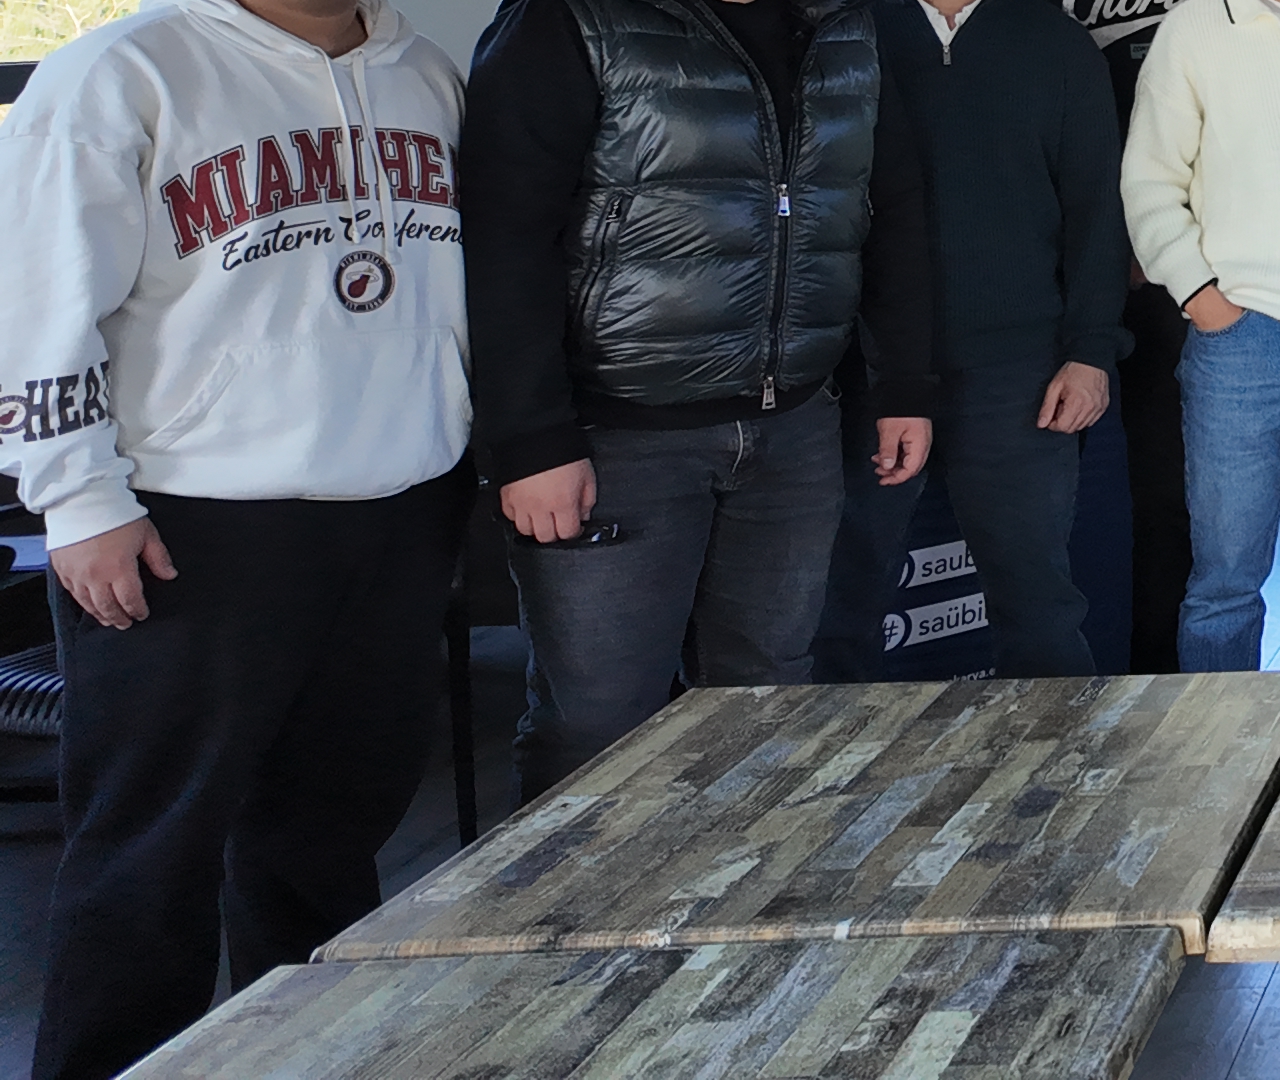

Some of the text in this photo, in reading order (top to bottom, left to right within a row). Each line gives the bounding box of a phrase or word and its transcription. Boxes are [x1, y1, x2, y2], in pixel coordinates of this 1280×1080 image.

[160, 125, 460, 260] MIAMI HE
[222, 208, 463, 270] Eastern Coferen
